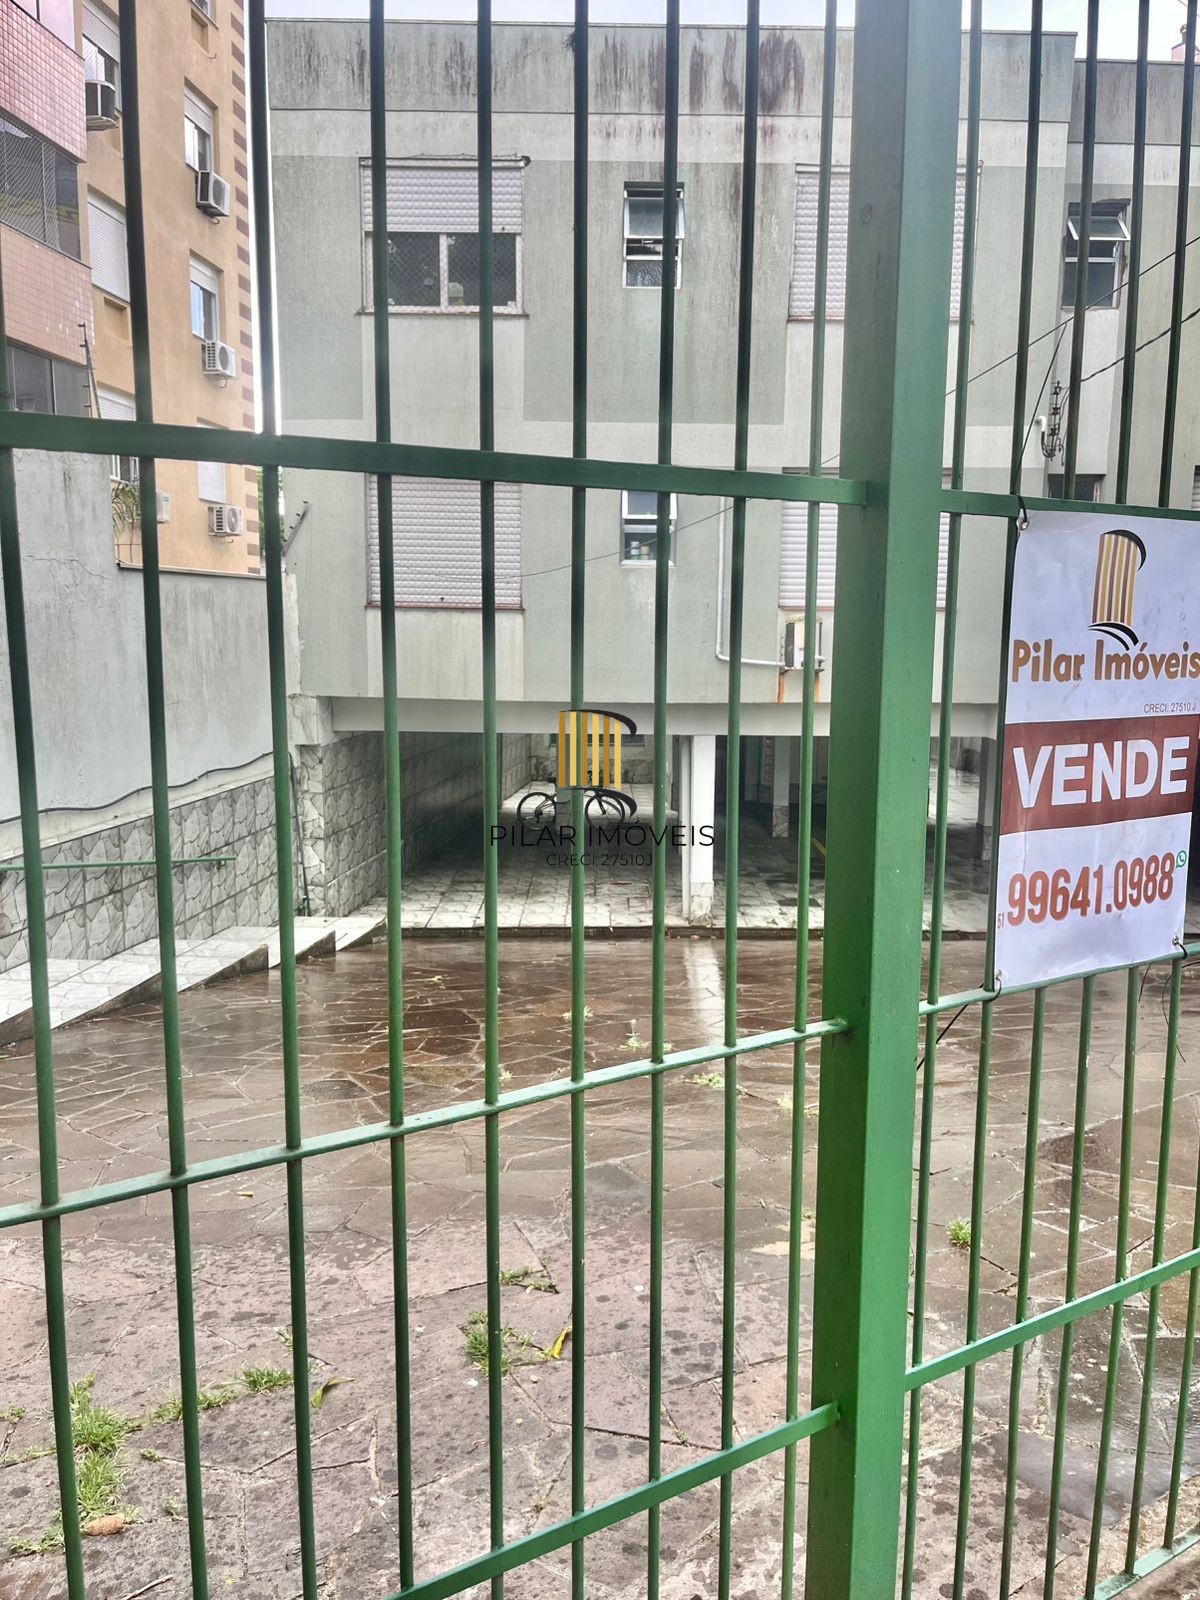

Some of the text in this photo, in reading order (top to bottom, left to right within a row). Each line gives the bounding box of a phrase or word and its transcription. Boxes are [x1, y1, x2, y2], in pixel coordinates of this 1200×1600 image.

[1011, 639, 1200, 682] Pilar Imóveis
[1143, 703, 1169, 714] CRECI:
[1170, 702, 1191, 712] 27510
[1012, 736, 1190, 809] VENDE
[1007, 851, 1175, 926] 99641.0988
